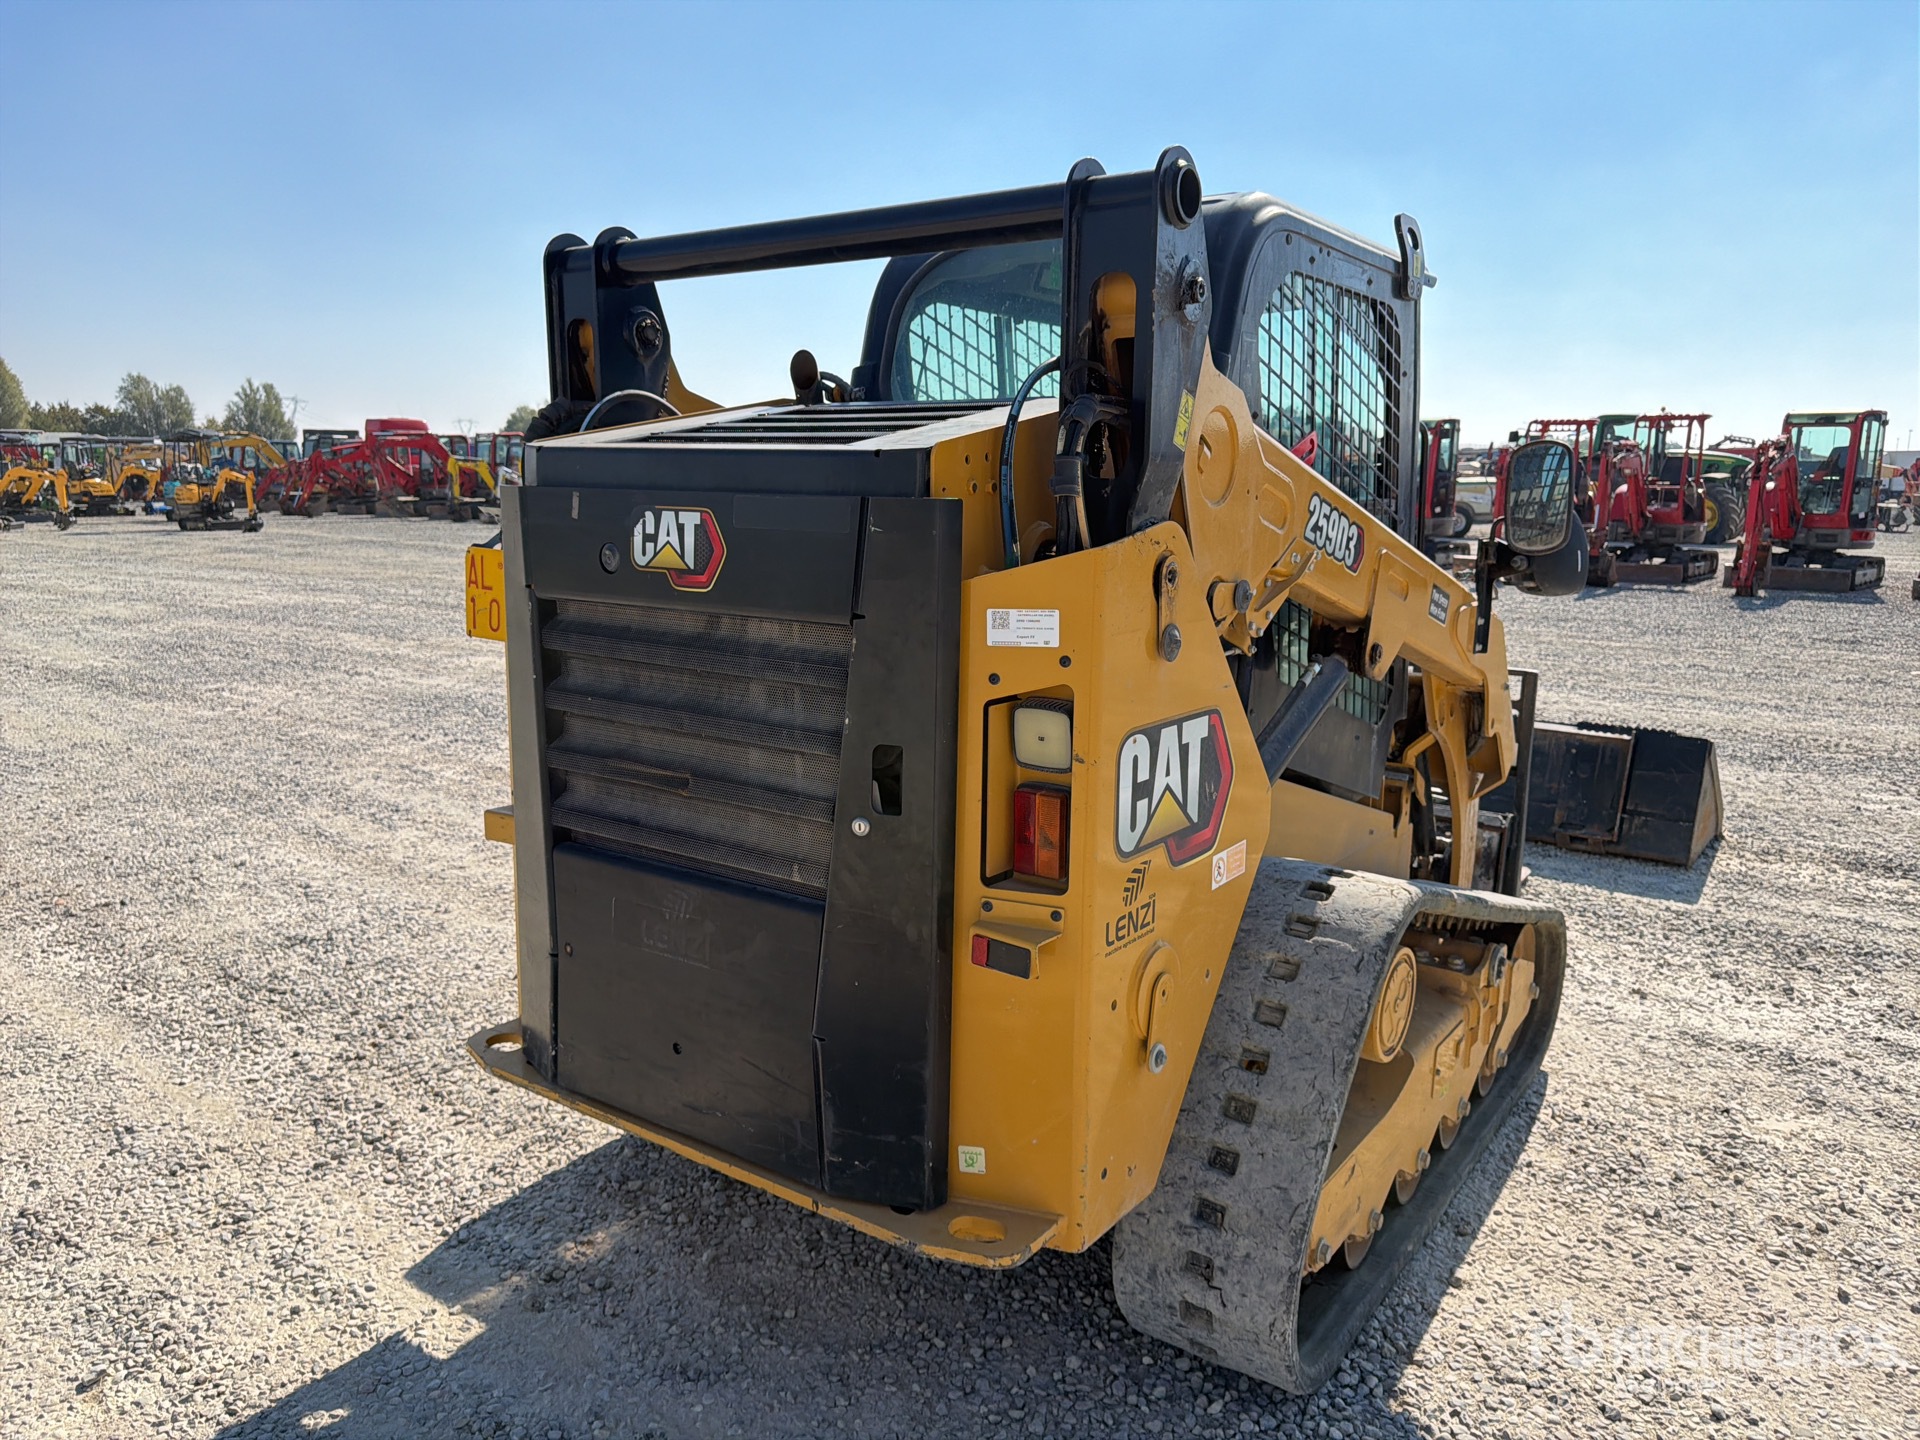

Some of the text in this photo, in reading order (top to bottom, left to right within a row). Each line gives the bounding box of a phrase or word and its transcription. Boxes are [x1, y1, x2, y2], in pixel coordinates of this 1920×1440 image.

[633, 510, 701, 570] CAT
[1304, 494, 1359, 568] 259D3
[1117, 714, 1210, 853] CAT
[1105, 899, 1156, 947] LENZI
